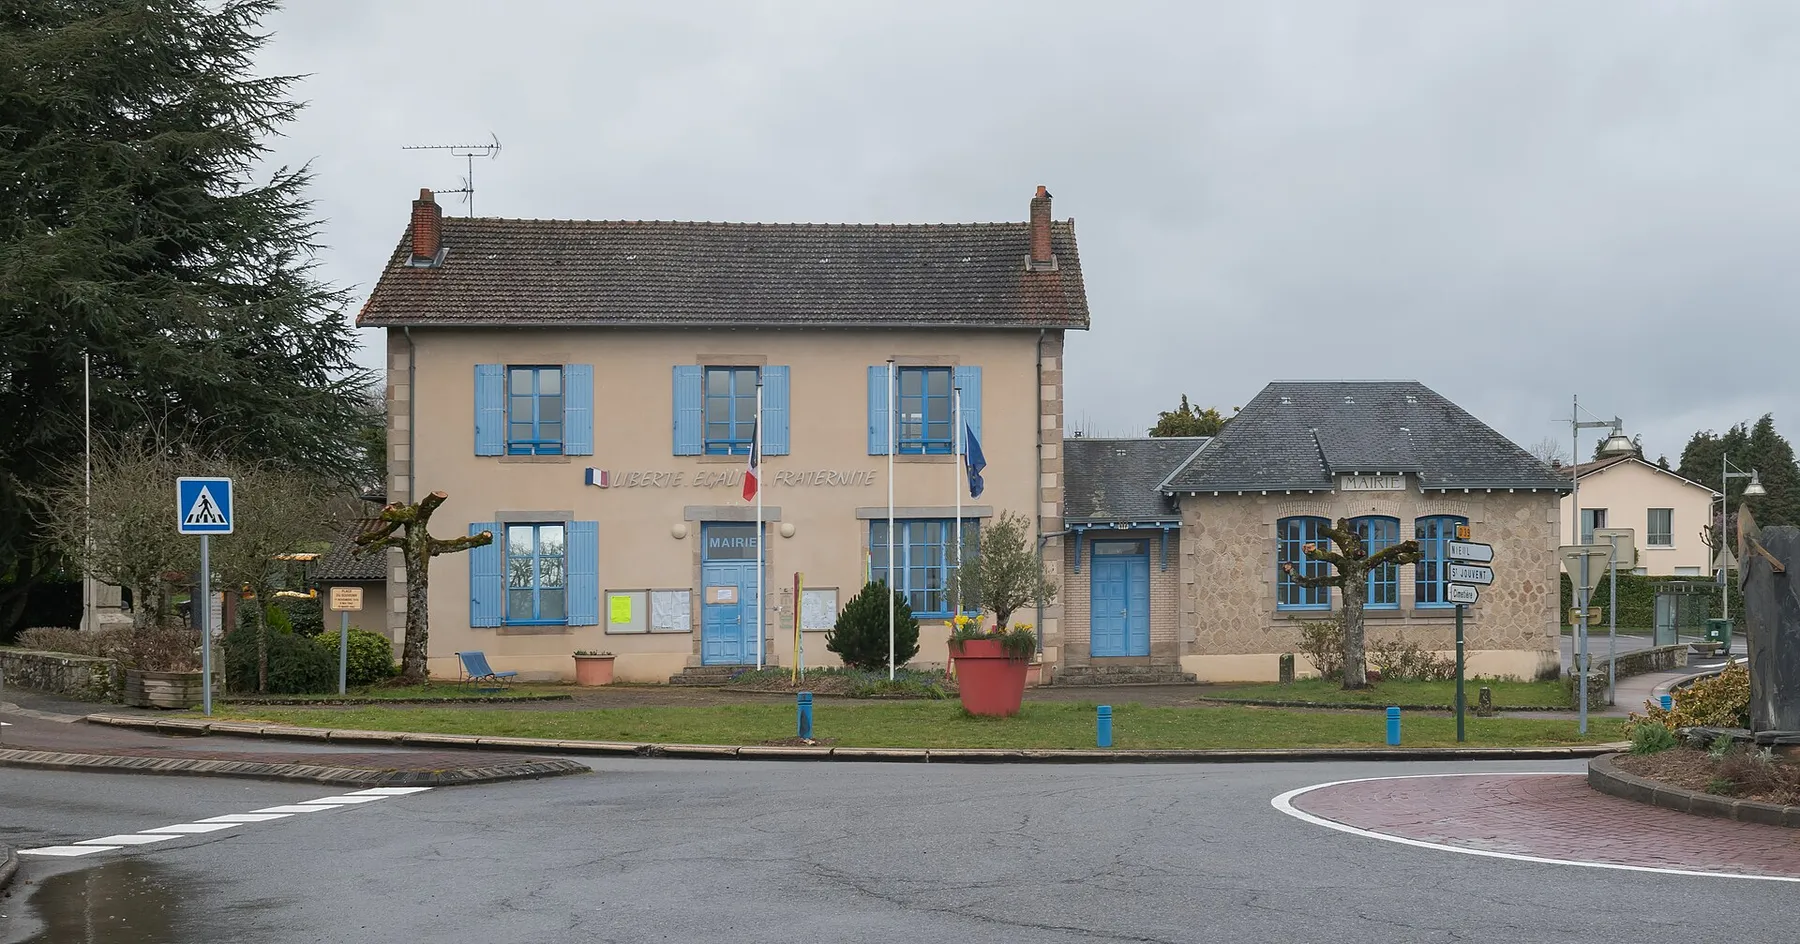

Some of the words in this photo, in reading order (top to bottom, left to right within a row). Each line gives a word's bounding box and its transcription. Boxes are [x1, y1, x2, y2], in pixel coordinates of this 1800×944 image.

[772, 469, 877, 487] FRATERNITE
[1345, 476, 1401, 488] MAIRIE
[710, 537, 757, 548] MAIRIE
[1460, 568, 1486, 580] JOUVENT
